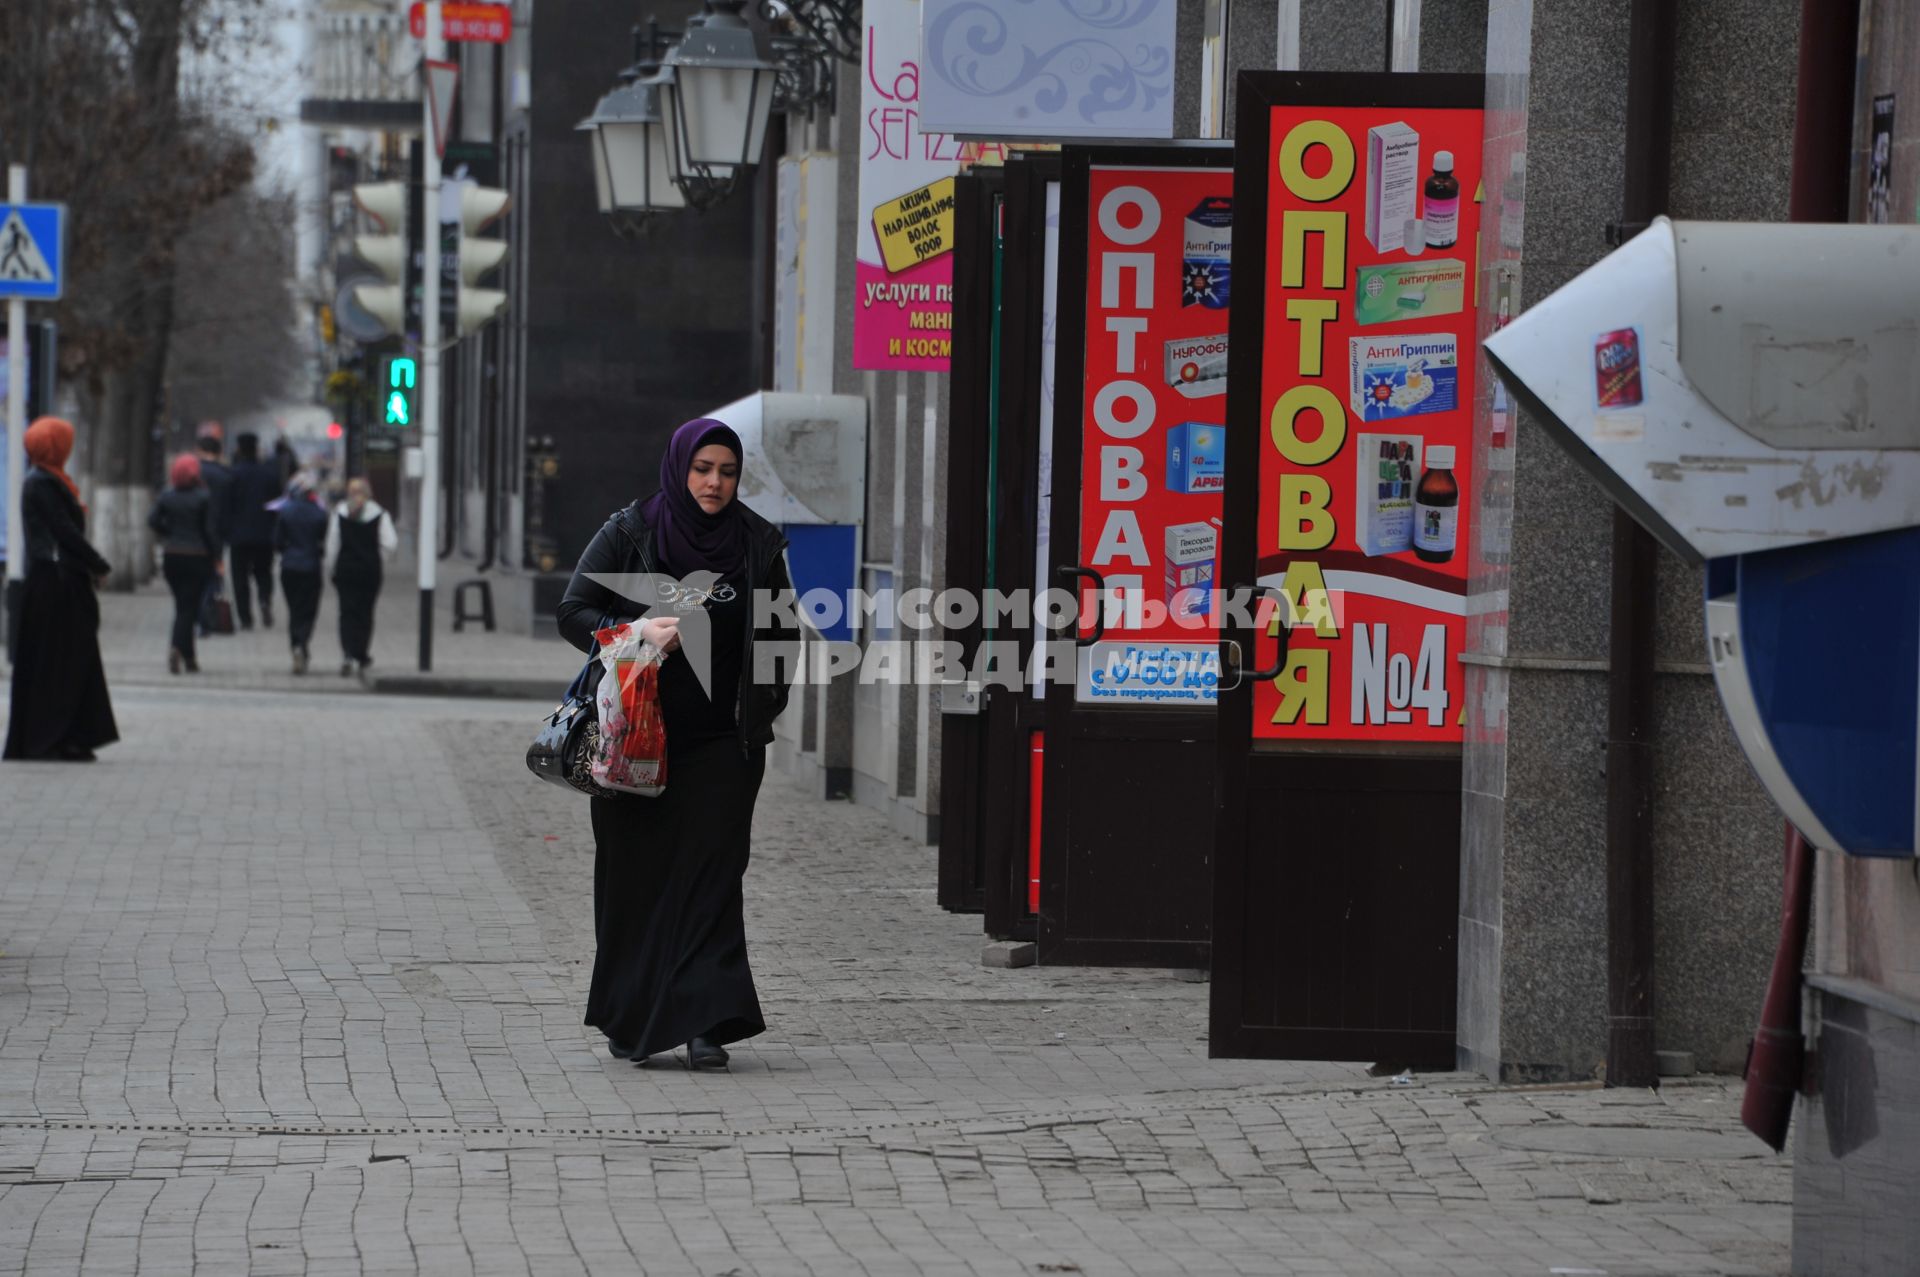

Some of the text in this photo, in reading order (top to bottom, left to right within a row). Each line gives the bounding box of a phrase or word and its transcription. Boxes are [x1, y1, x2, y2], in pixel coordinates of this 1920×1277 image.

[869, 25, 919, 103] La
[899, 187, 932, 213] АКЦИЯ
[907, 218, 941, 244] ВОЛОС
[1398, 271, 1462, 286] АНТИГРИППИН
[864, 282, 930, 309] услуги
[889, 338, 901, 356] и
[1367, 343, 1455, 359] АнтиГриппин
[1092, 185, 1162, 630] ОПТОВАЯ
[1267, 119, 1356, 725] ОПТОВАЯ
[1379, 440, 1414, 461] ПАРА
[1180, 536, 1214, 547] Гексорал
[1180, 544, 1215, 556] аэрозоль
[1091, 669, 1105, 685] с
[1182, 670, 1218, 689] до
[1350, 622, 1448, 727] №4
[1119, 688, 1199, 701] перерыва,
